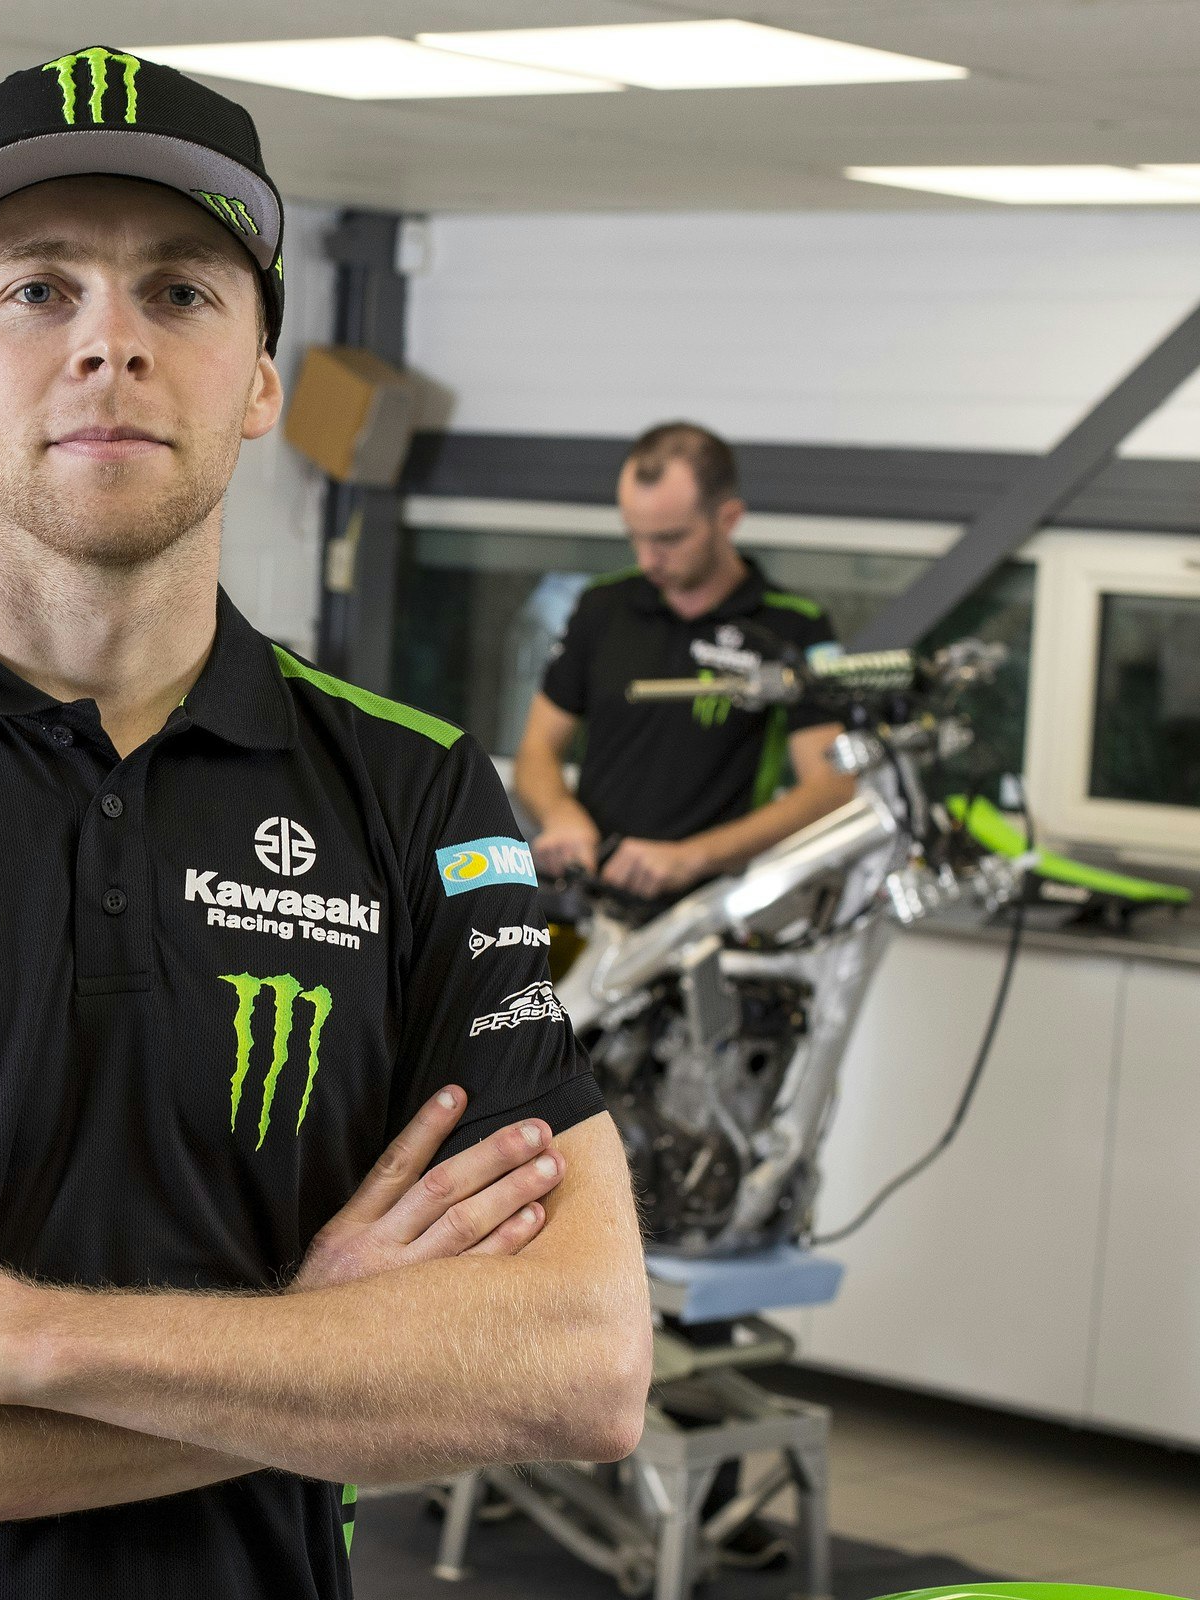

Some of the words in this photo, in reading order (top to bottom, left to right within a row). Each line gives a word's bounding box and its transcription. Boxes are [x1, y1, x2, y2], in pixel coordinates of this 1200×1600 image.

[184, 868, 380, 934] Kawasaki
[207, 908, 294, 940] Racing
[298, 920, 361, 950] Team
